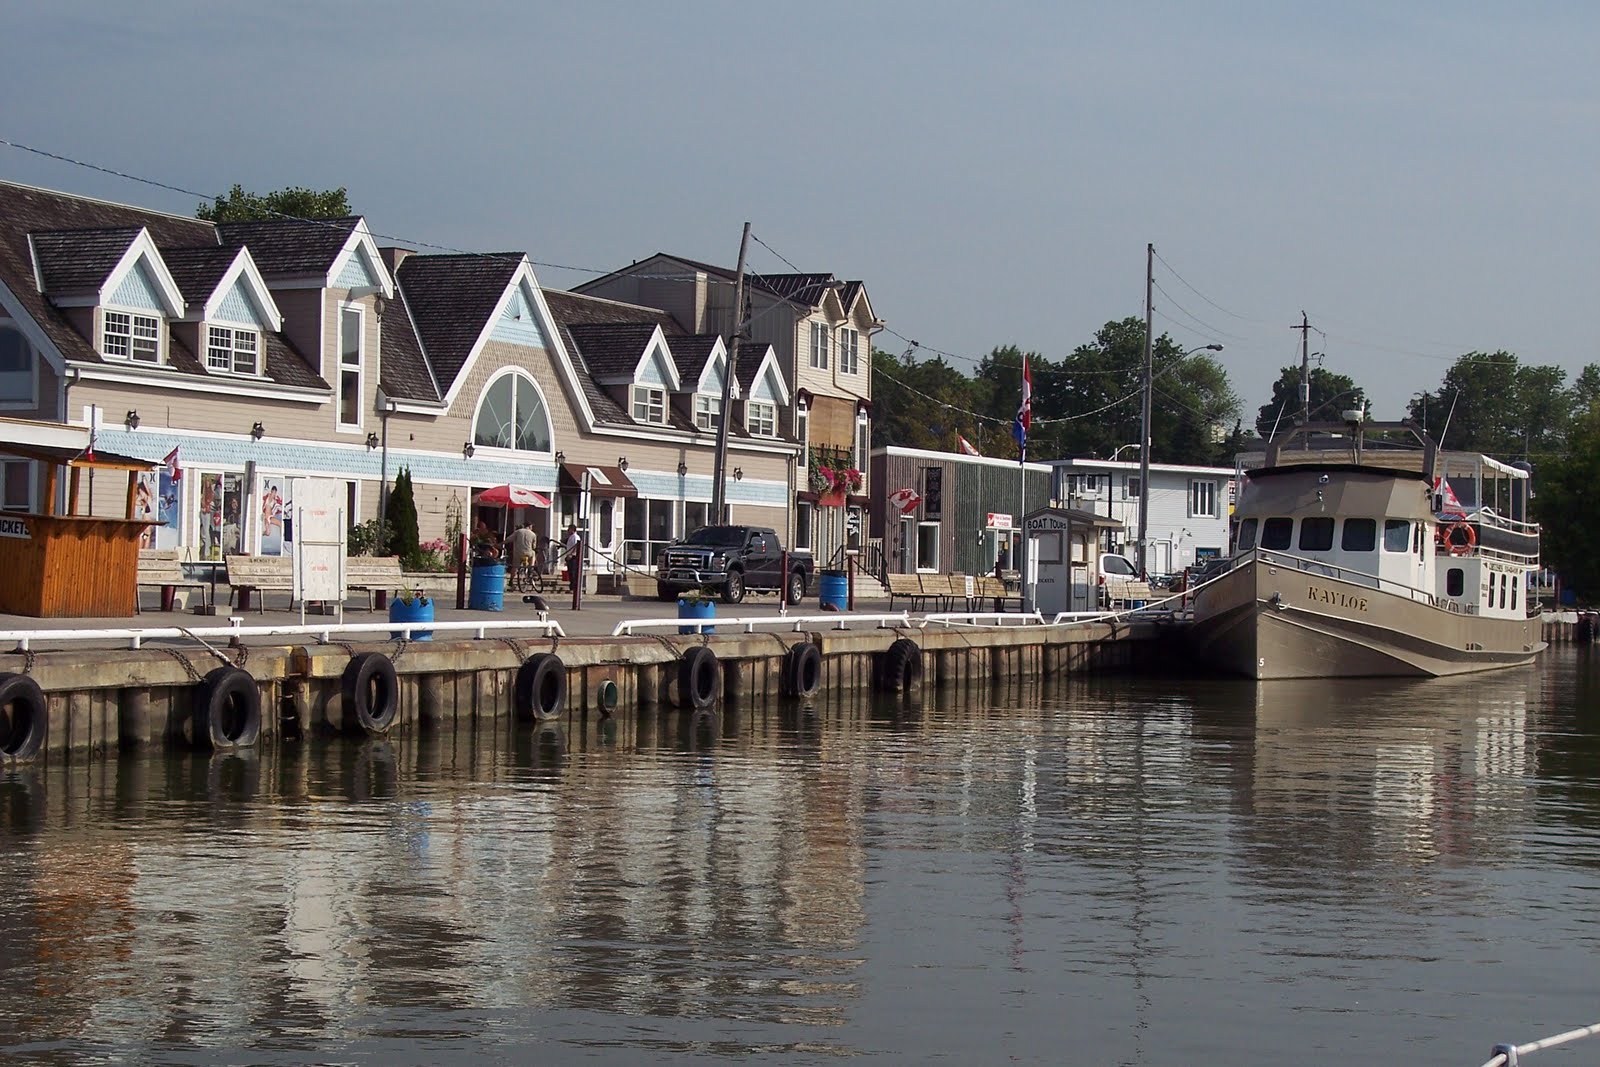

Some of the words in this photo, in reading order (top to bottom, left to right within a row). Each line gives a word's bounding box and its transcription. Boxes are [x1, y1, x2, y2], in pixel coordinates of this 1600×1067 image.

[1028, 518, 1047, 529] BOAT
[1050, 518, 1067, 529] TOURS
[1308, 586, 1368, 612] KAYLOE
[1259, 657, 1265, 667] 5
